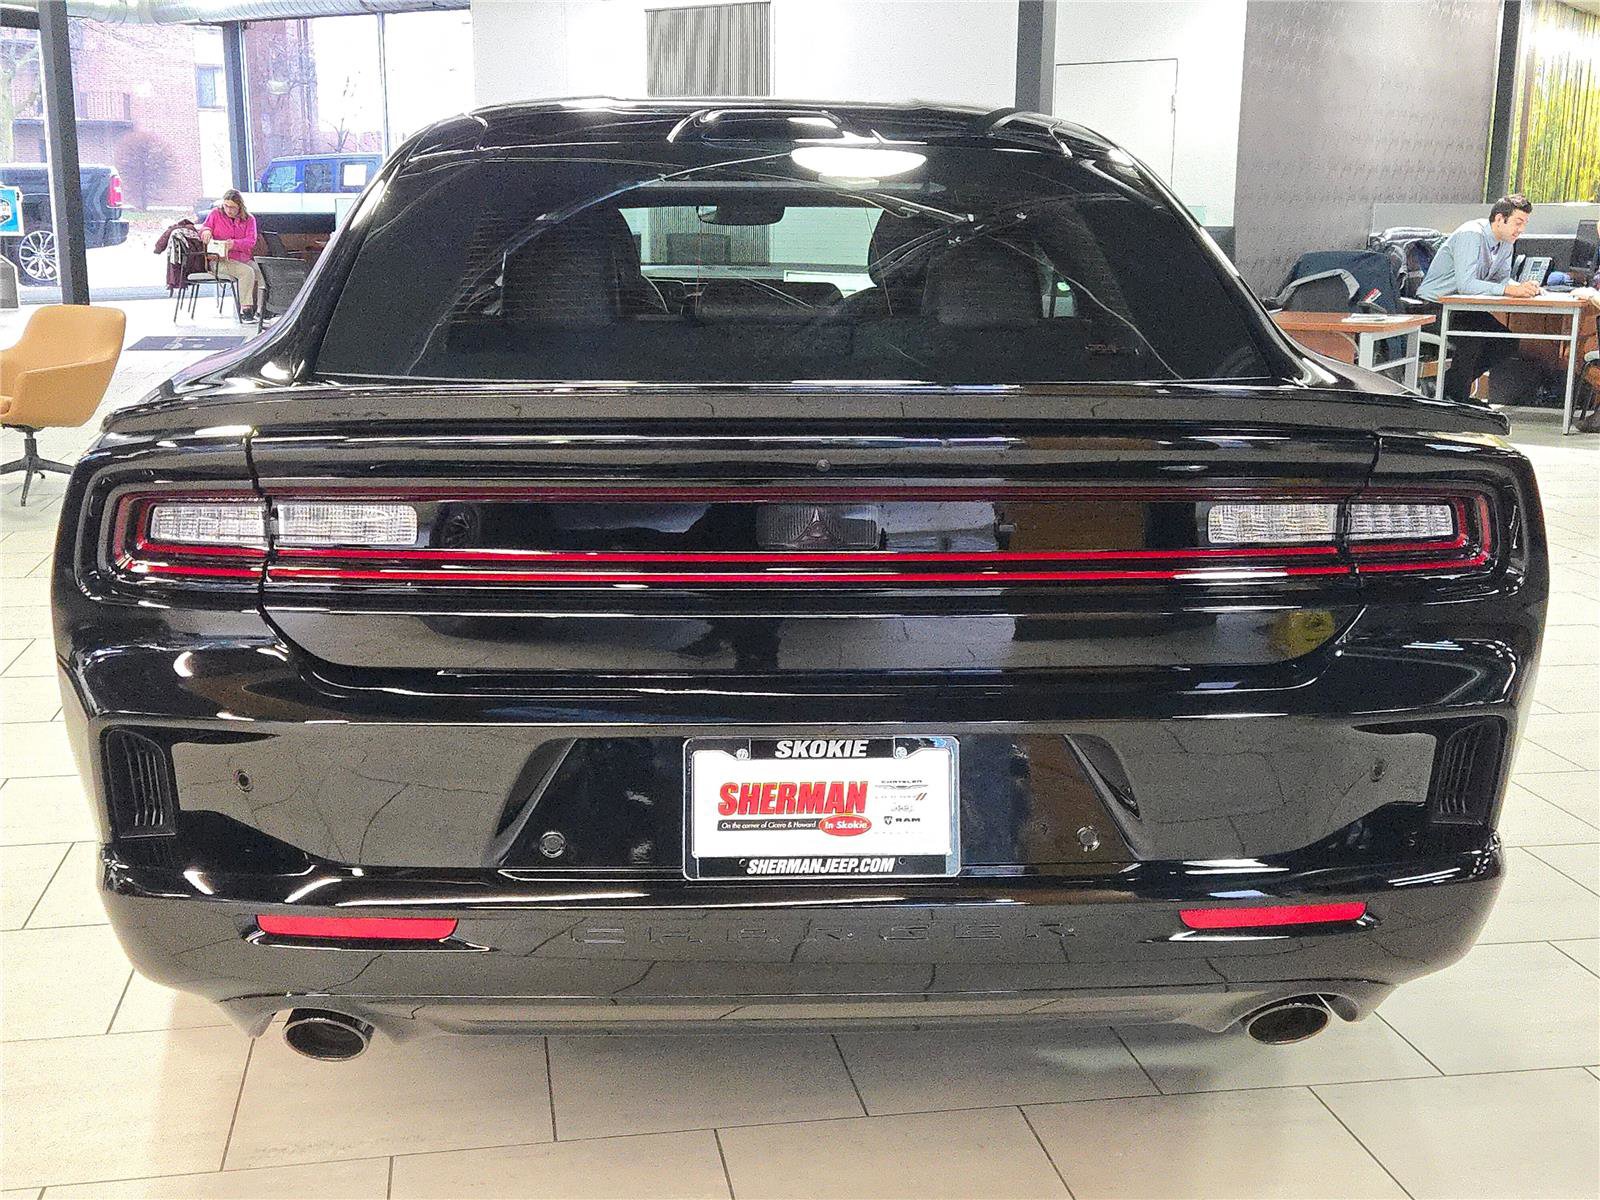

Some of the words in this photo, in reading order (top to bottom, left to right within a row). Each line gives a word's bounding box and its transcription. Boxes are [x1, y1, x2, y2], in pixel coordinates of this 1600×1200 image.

[775, 740, 868, 758] SKOKIE
[717, 781, 868, 816] SHERMAN
[732, 820, 741, 829] the
[742, 821, 760, 829] corner
[761, 819, 768, 828] of
[768, 820, 787, 828] Cicero
[788, 820, 793, 828] &
[793, 820, 817, 828] Howard
[824, 821, 834, 829] In
[836, 820, 868, 829] Skokie
[746, 857, 895, 874] SHERMANJEEP.COM
